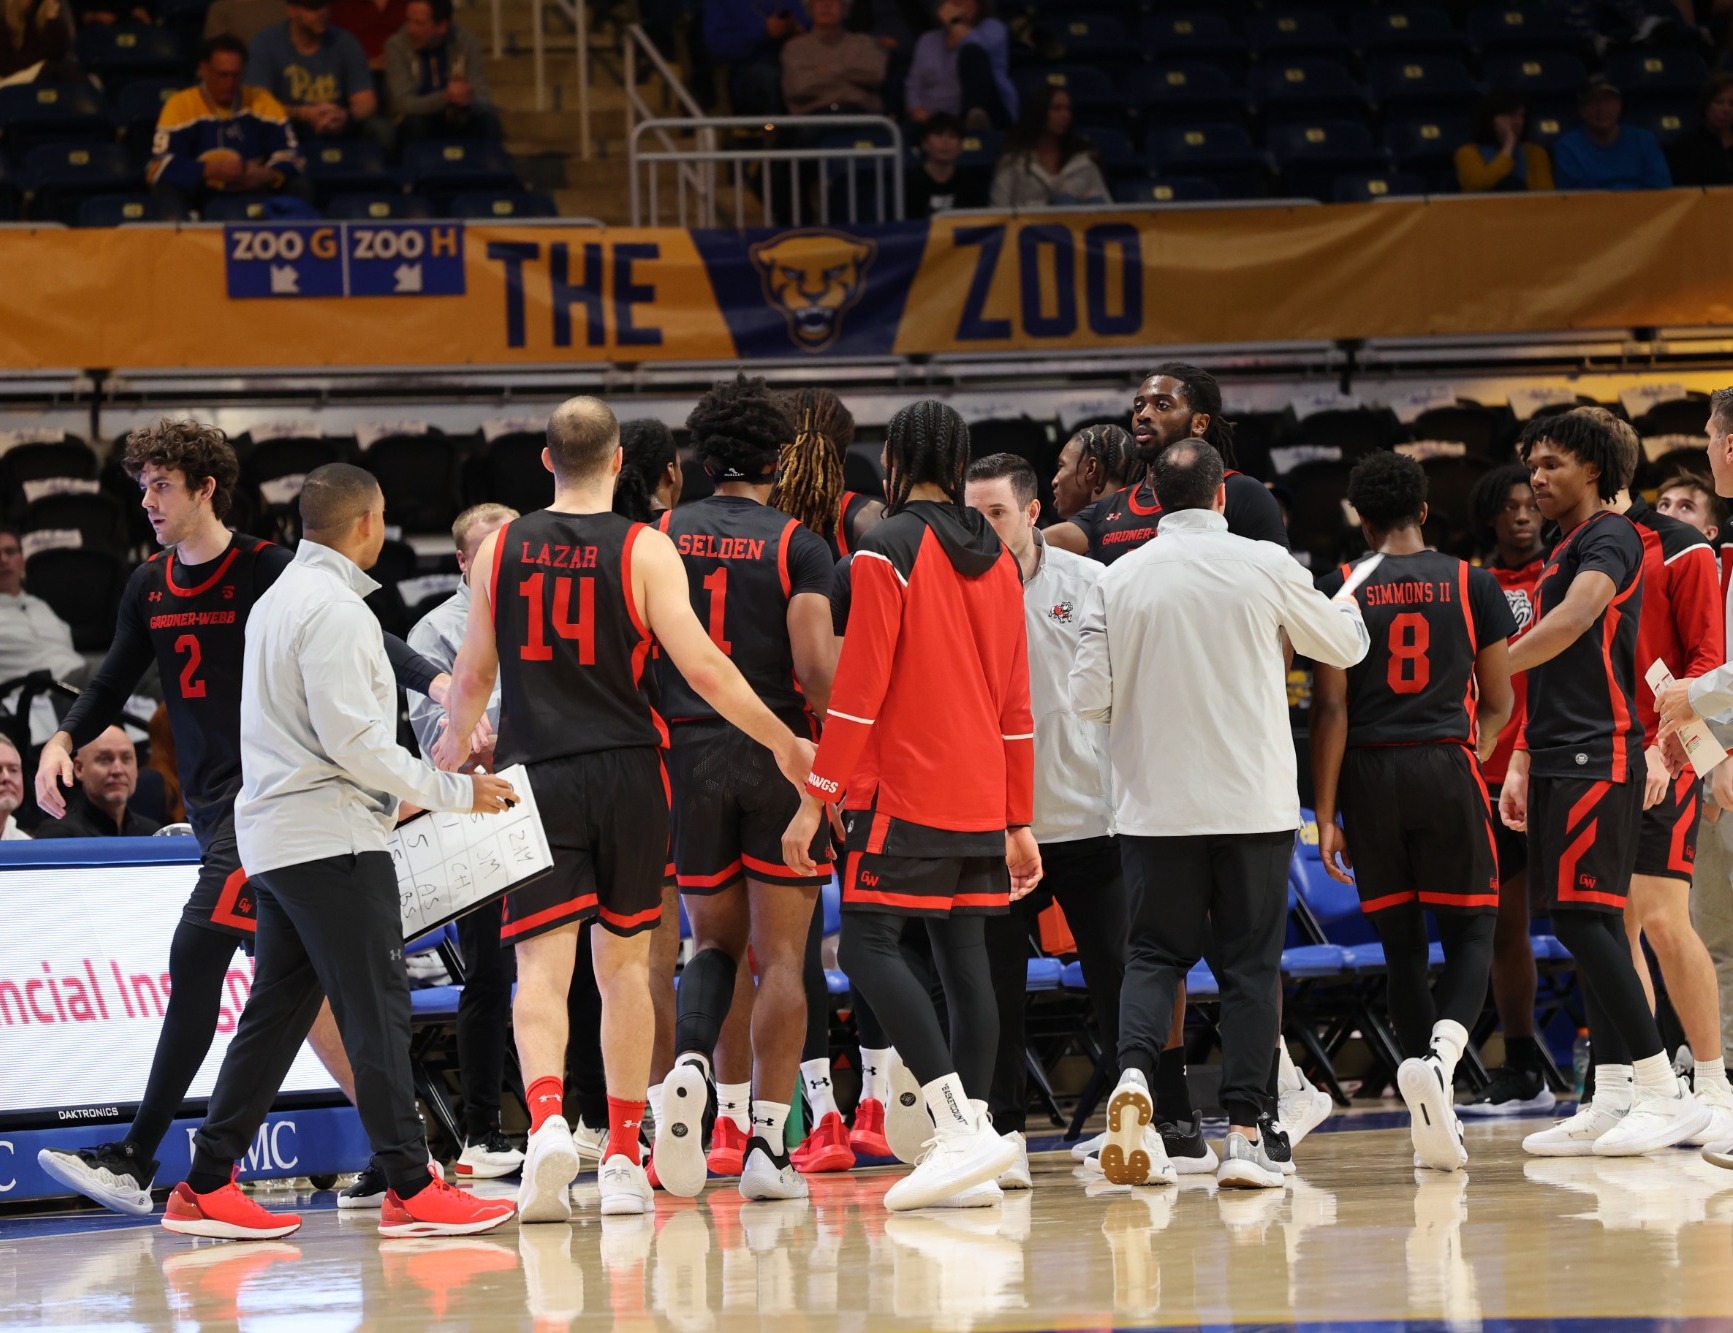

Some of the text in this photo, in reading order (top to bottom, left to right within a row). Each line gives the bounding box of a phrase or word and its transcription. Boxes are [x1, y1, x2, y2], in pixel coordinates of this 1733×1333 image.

[232, 228, 338, 260] ZOO G
[353, 227, 457, 259] ZOO H
[487, 223, 1144, 348] THE ZOO
[678, 534, 765, 560] SELDEN
[1102, 527, 1159, 546] GARDNER-
[521, 541, 598, 568] LAZAR
[1366, 581, 1451, 606] SIMMONS II
[150, 611, 236, 630] GARDNER-WEBB
[519, 572, 596, 665] 14
[703, 566, 732, 656] 1
[174, 633, 207, 699] 2
[1387, 612, 1430, 694] 8
[1579, 873, 1596, 889] GW
[0, 958, 109, 1027] ncial
[58, 1106, 119, 1120] DAKTRONICS
